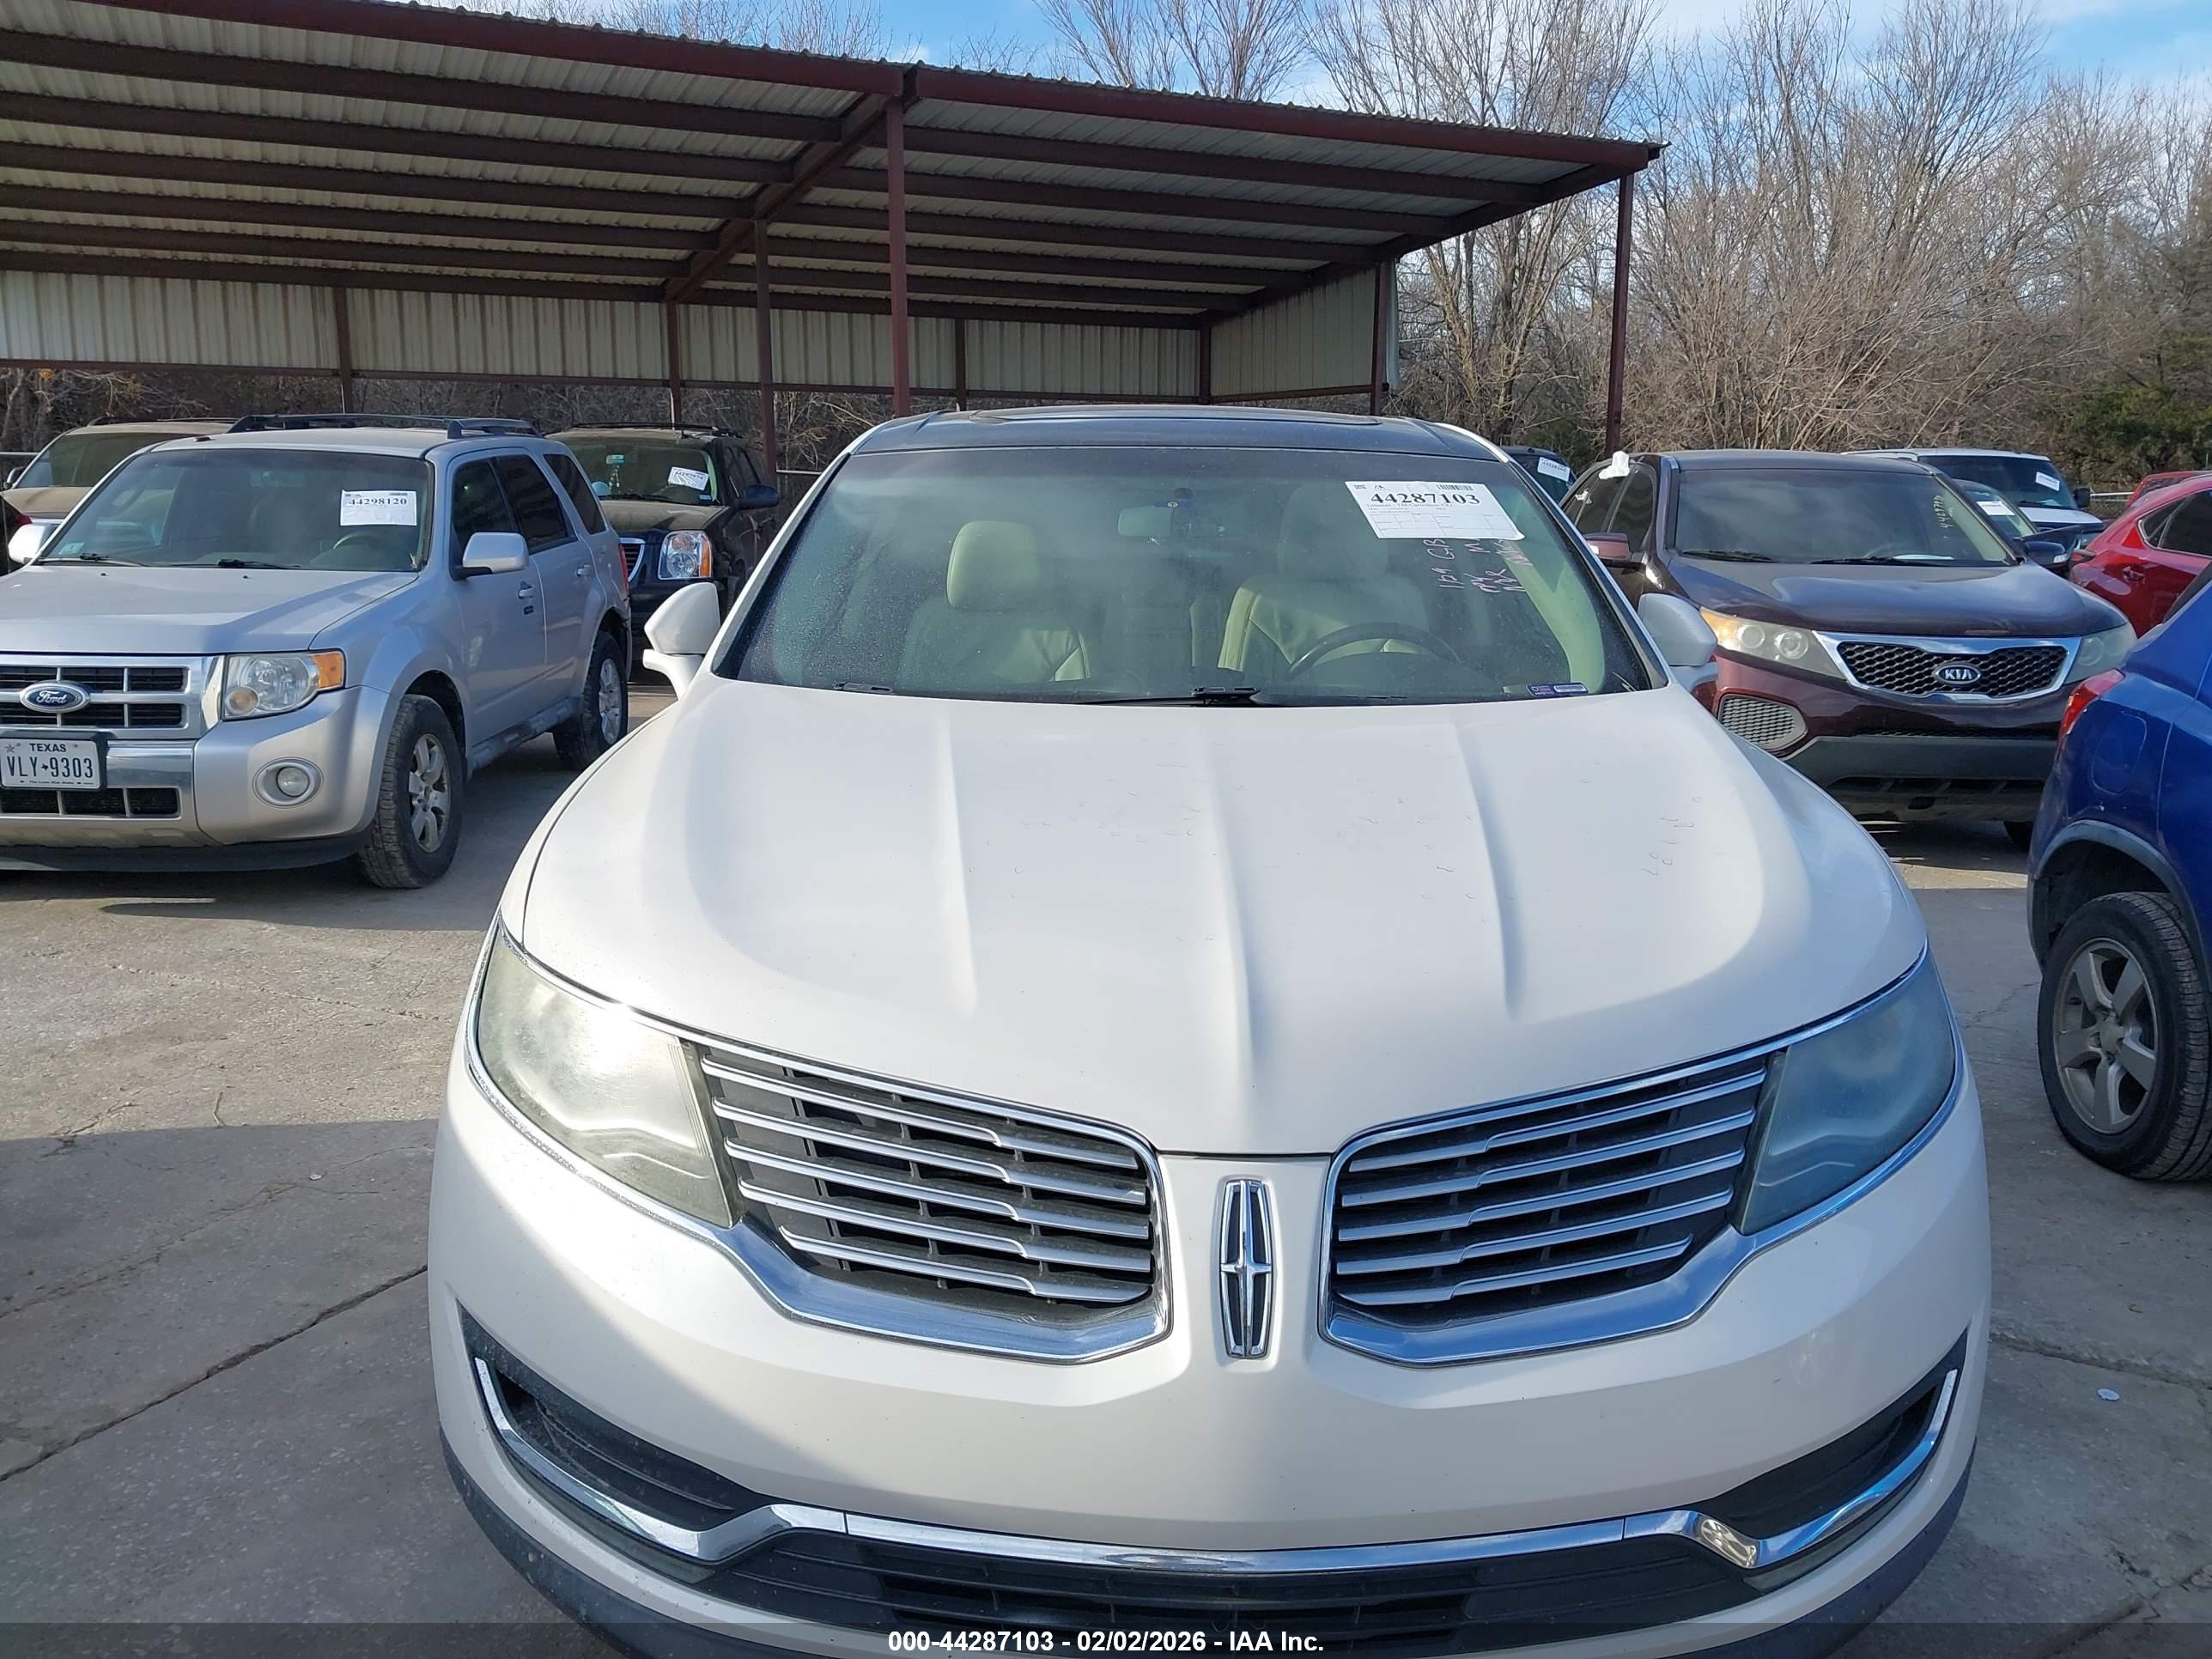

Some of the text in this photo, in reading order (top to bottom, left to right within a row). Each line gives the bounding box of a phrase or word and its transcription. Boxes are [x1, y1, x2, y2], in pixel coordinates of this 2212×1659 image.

[1370, 493, 1481, 505] 44287103
[1945, 669, 1972, 680] KIA
[36, 690, 67, 704] Ford
[29, 743, 67, 753] TEXAS
